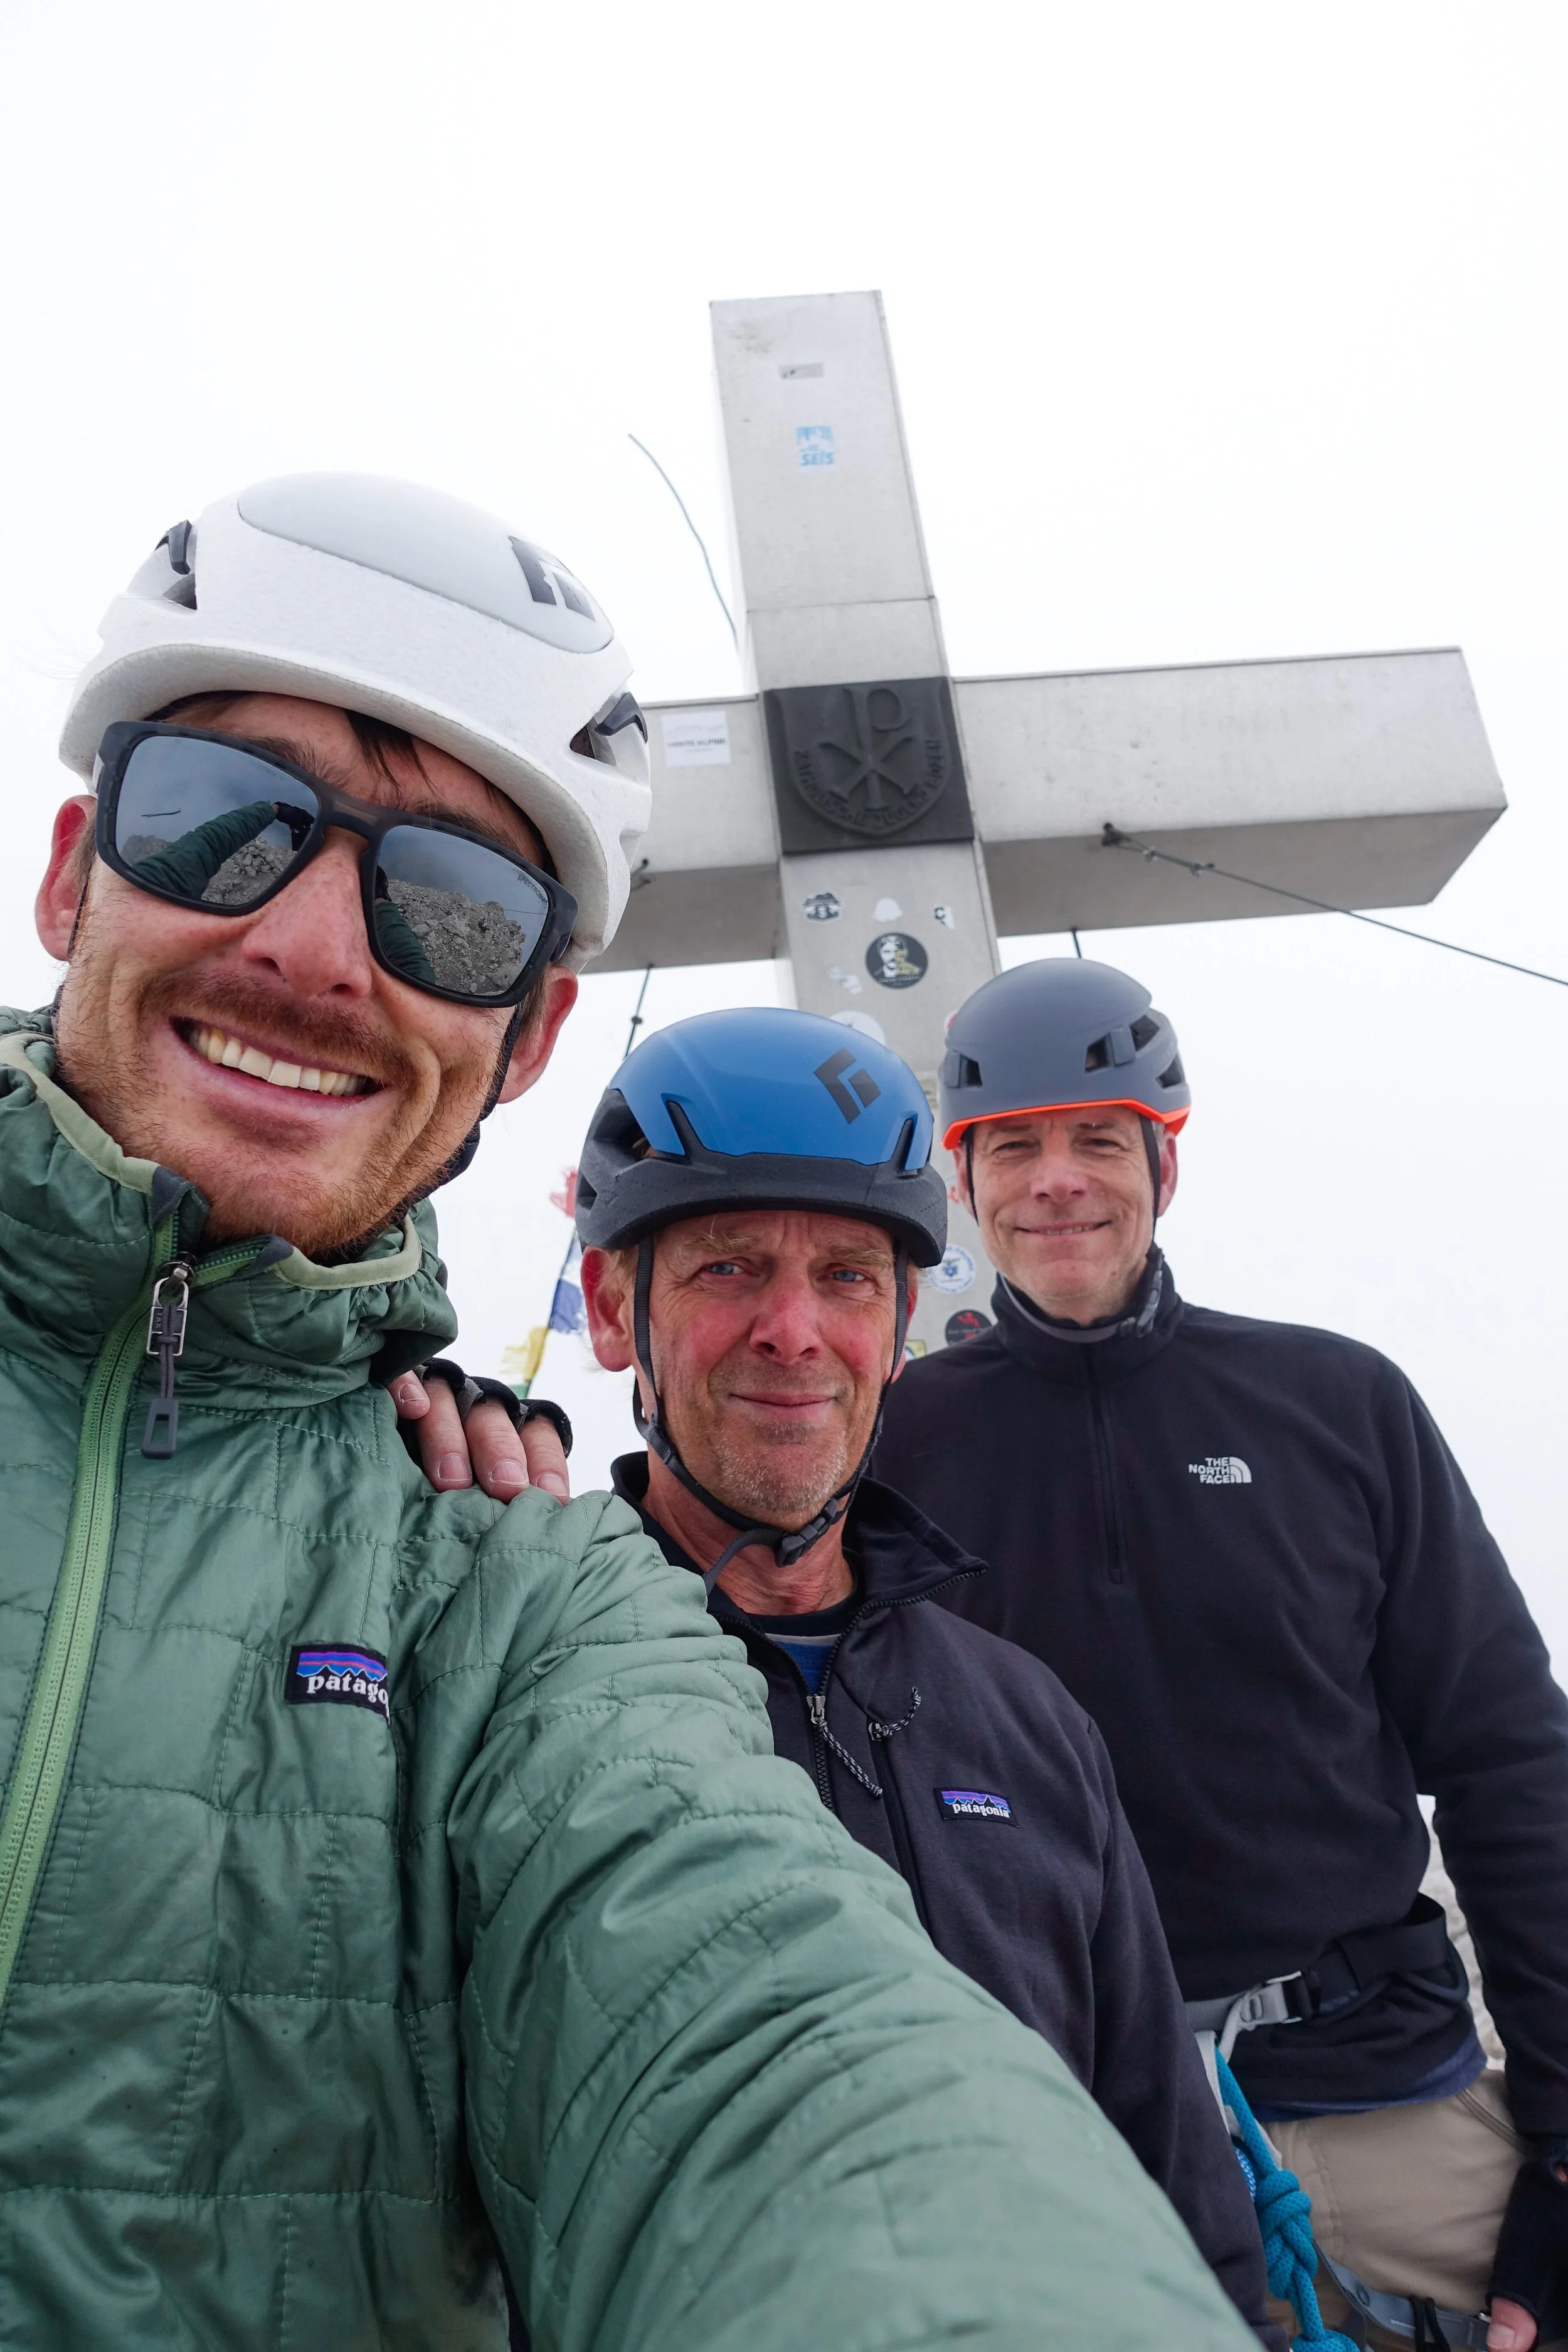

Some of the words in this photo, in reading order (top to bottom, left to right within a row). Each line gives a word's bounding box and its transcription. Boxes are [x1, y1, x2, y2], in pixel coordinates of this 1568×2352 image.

[1204, 1457, 1229, 1466] THE
[1188, 1464, 1230, 1475] NORTH
[1200, 1475, 1230, 1485] FACE
[307, 1675, 390, 1722] patago
[951, 1803, 1010, 1818] patagonia
